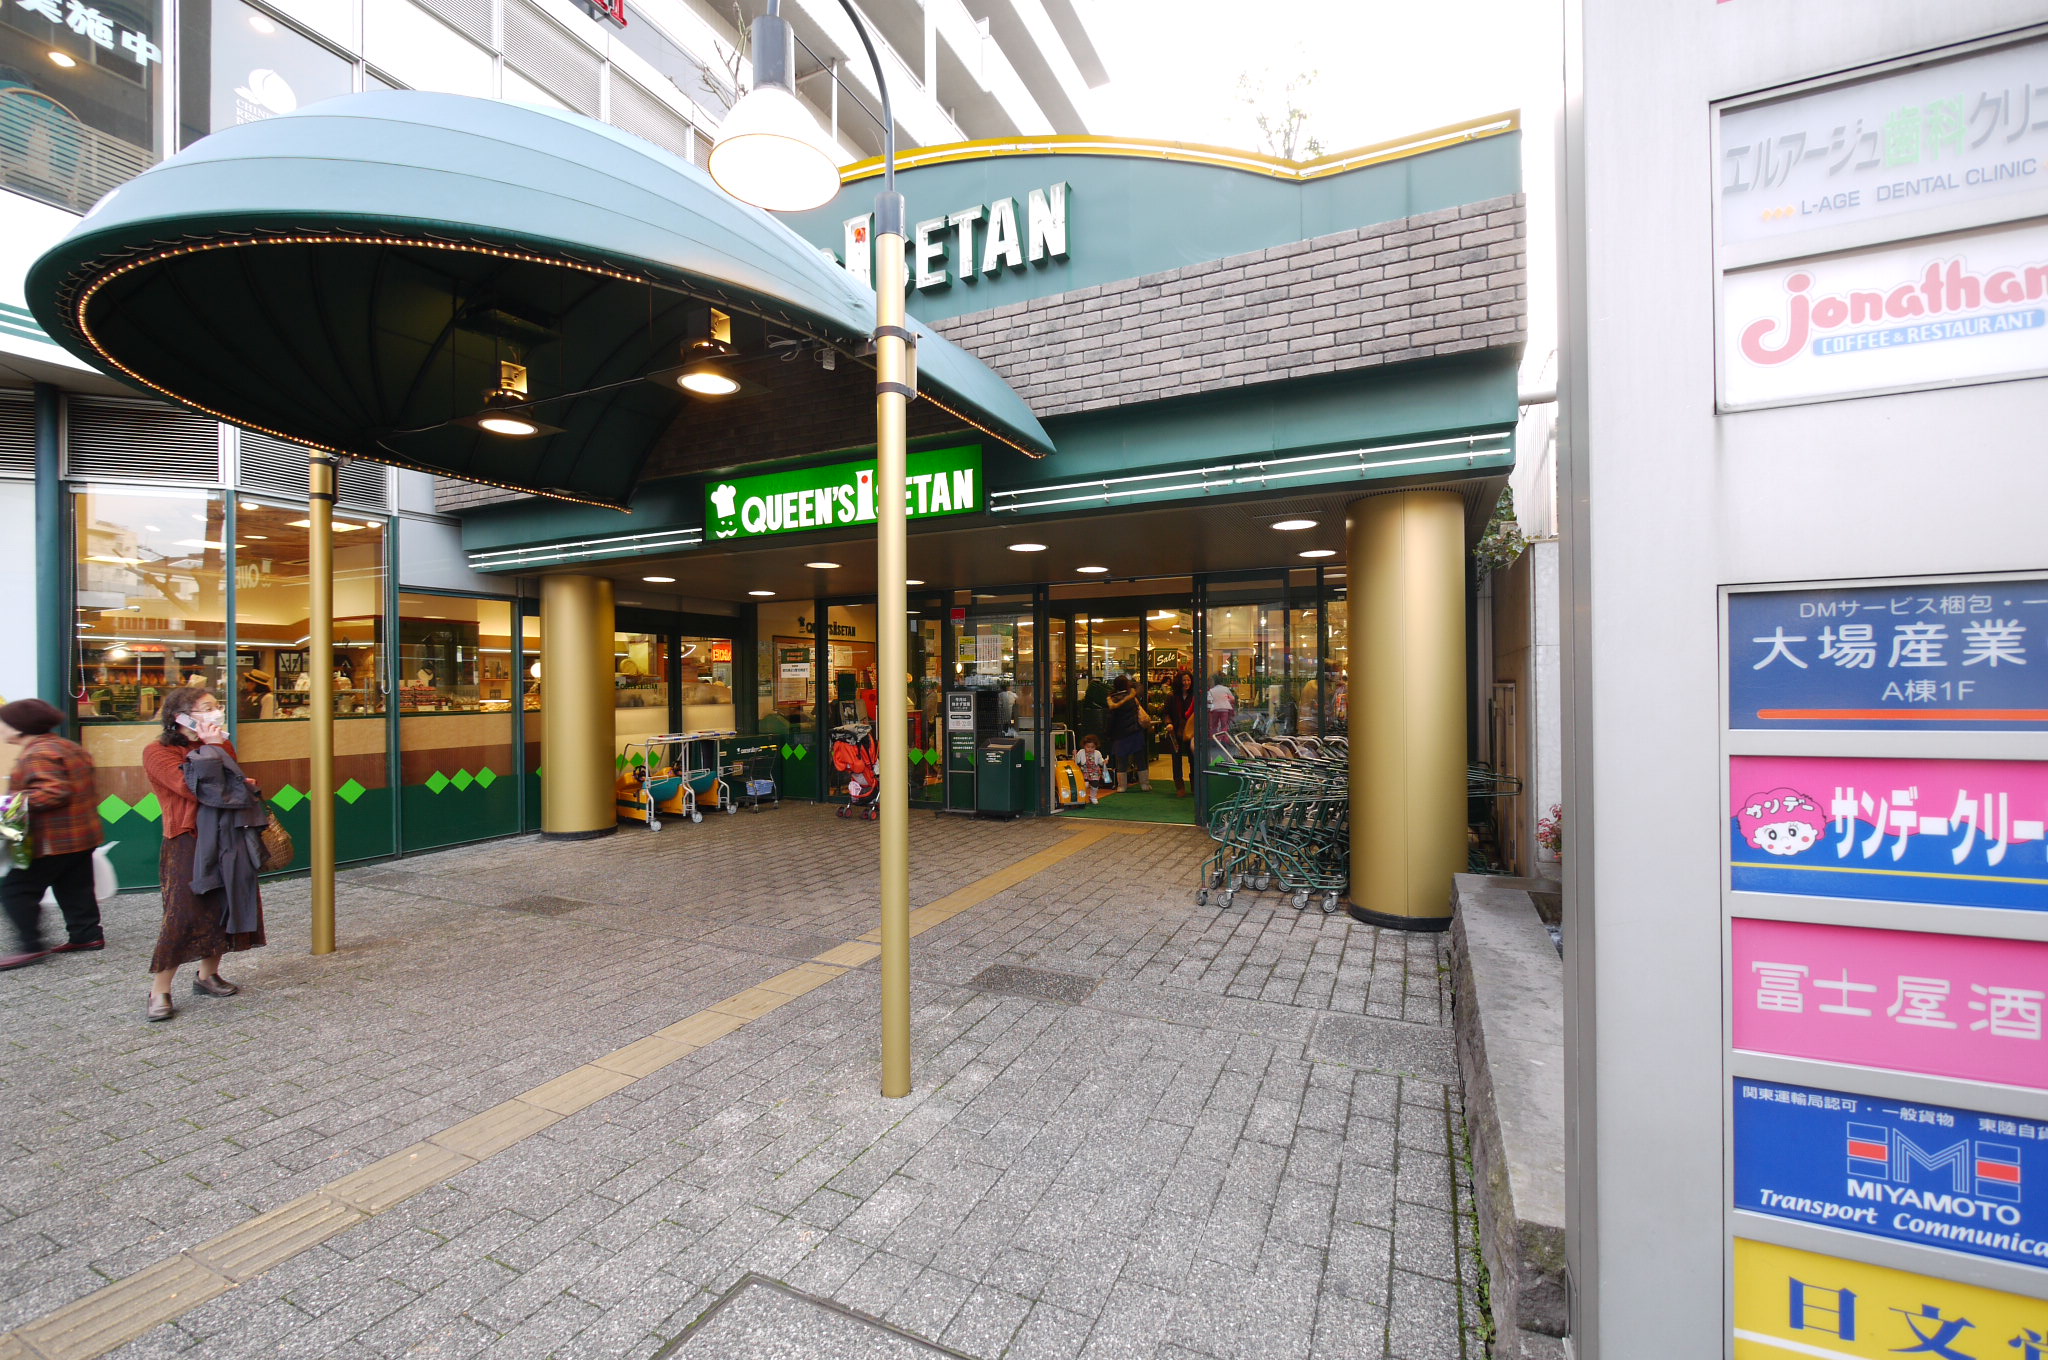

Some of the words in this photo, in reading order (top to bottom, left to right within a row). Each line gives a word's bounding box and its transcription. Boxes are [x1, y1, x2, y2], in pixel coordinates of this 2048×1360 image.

[1801, 190, 1861, 216] L-AGE
[1876, 173, 1960, 203] DENTAL
[1965, 158, 2037, 186] CLINIC
[843, 181, 1070, 290] IETAN
[1821, 329, 1890, 355] COFFEE
[1907, 311, 2035, 342] RESTAURANT
[741, 483, 856, 533] QUEEN'S
[855, 468, 974, 522] IETAN
[1157, 652, 1176, 666] Sale
[1752, 618, 2028, 670] 大場産業
[1882, 680, 1976, 702] A棟1F
[1746, 796, 1815, 819] サンデー
[1831, 786, 2045, 867] サンデークリー
[1760, 1188, 1878, 1225] Transport
[1847, 1178, 2022, 1226] MIYAMOTO
[1788, 1276, 2048, 1360] 日文
